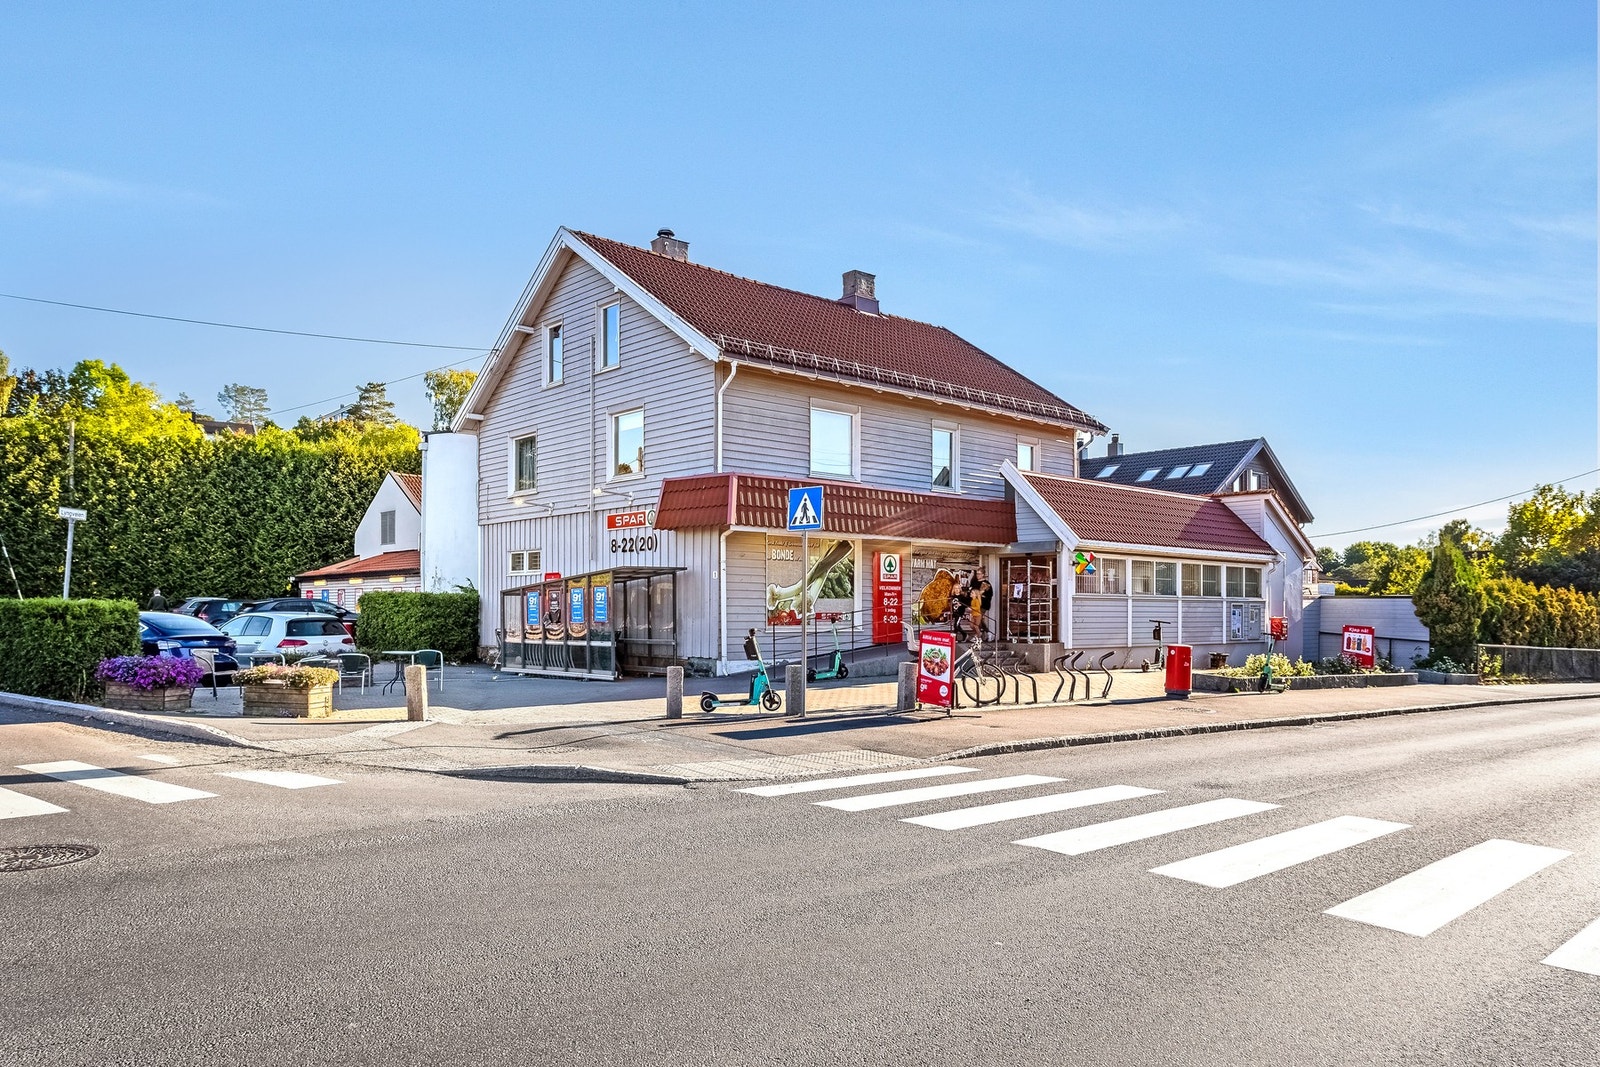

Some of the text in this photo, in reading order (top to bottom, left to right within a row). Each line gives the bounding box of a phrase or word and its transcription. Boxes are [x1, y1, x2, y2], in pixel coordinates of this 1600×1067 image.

[615, 513, 645, 527] SPAR
[611, 533, 658, 555] 8-22(20)
[883, 597, 898, 606] 8-22
